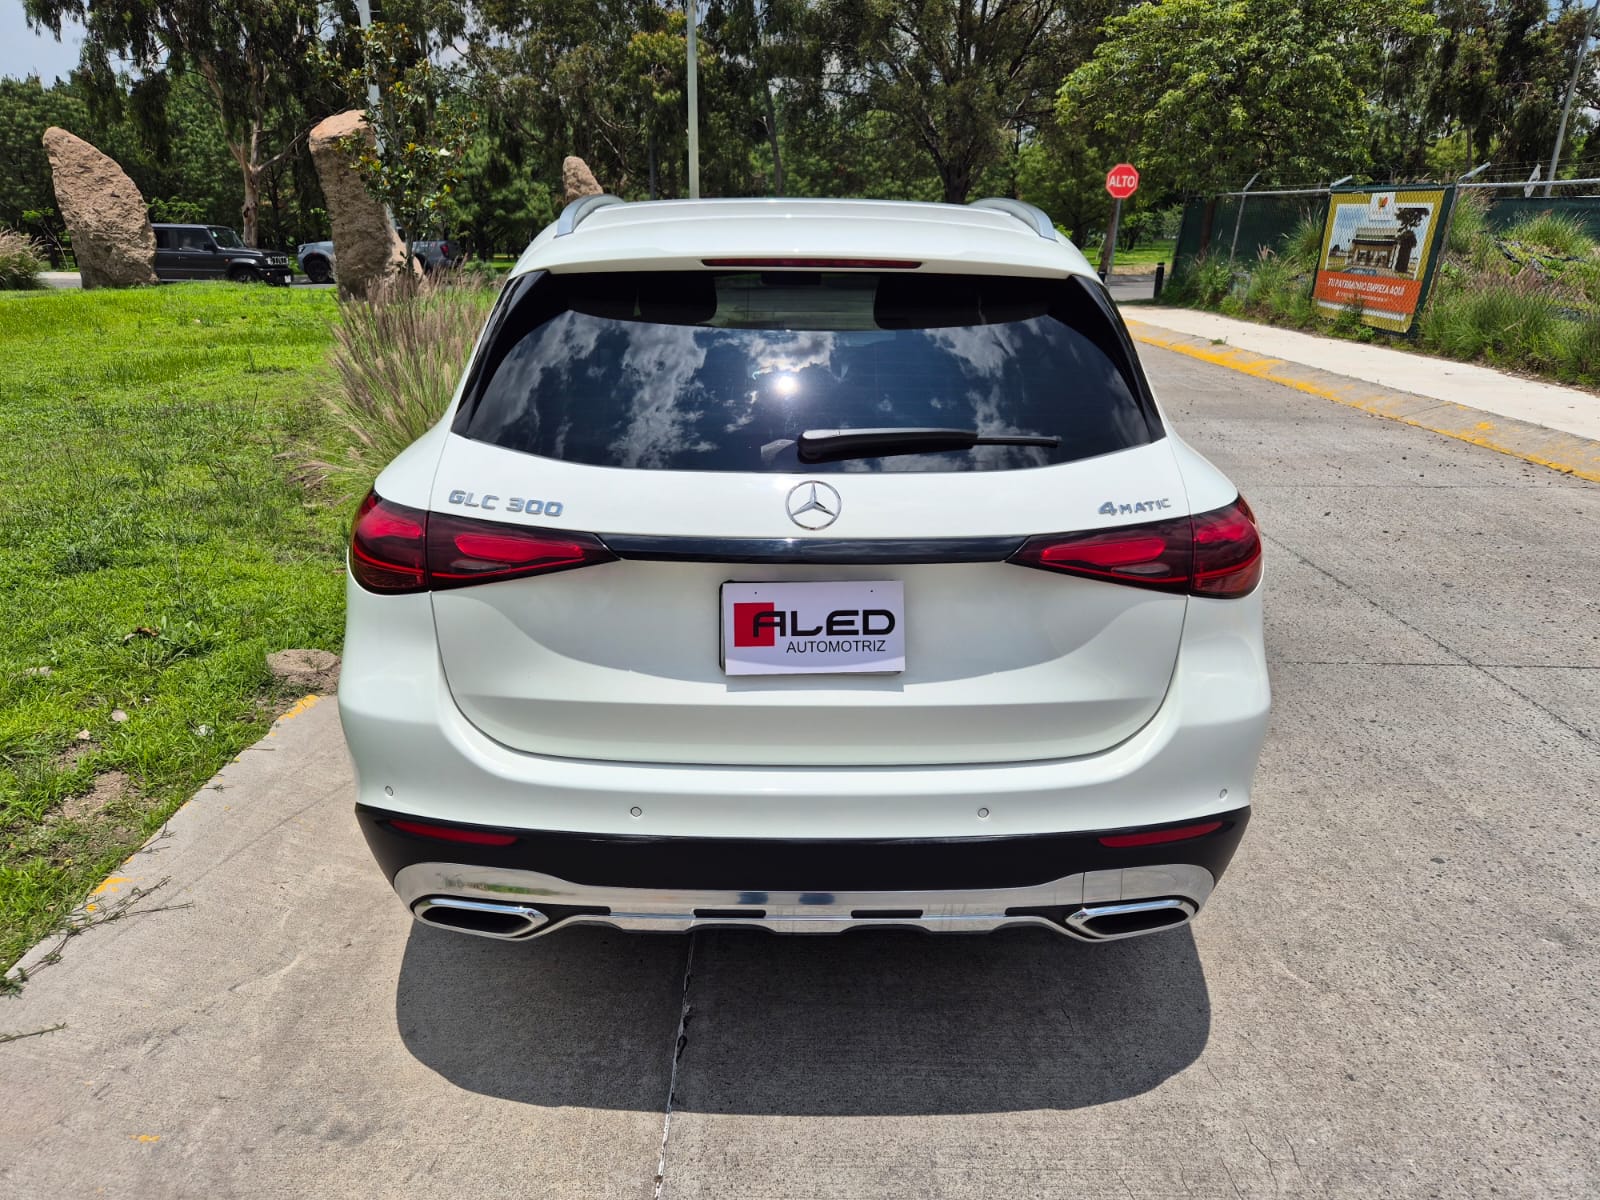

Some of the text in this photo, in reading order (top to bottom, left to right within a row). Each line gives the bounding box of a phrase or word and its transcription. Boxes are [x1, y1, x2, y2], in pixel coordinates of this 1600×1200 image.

[1109, 175, 1136, 188] ALTO
[448, 489, 564, 517] GLC 300
[1098, 498, 1171, 516] 4MATIC
[753, 609, 896, 638] ALED
[786, 640, 886, 653] AUTOMOTRIZ
